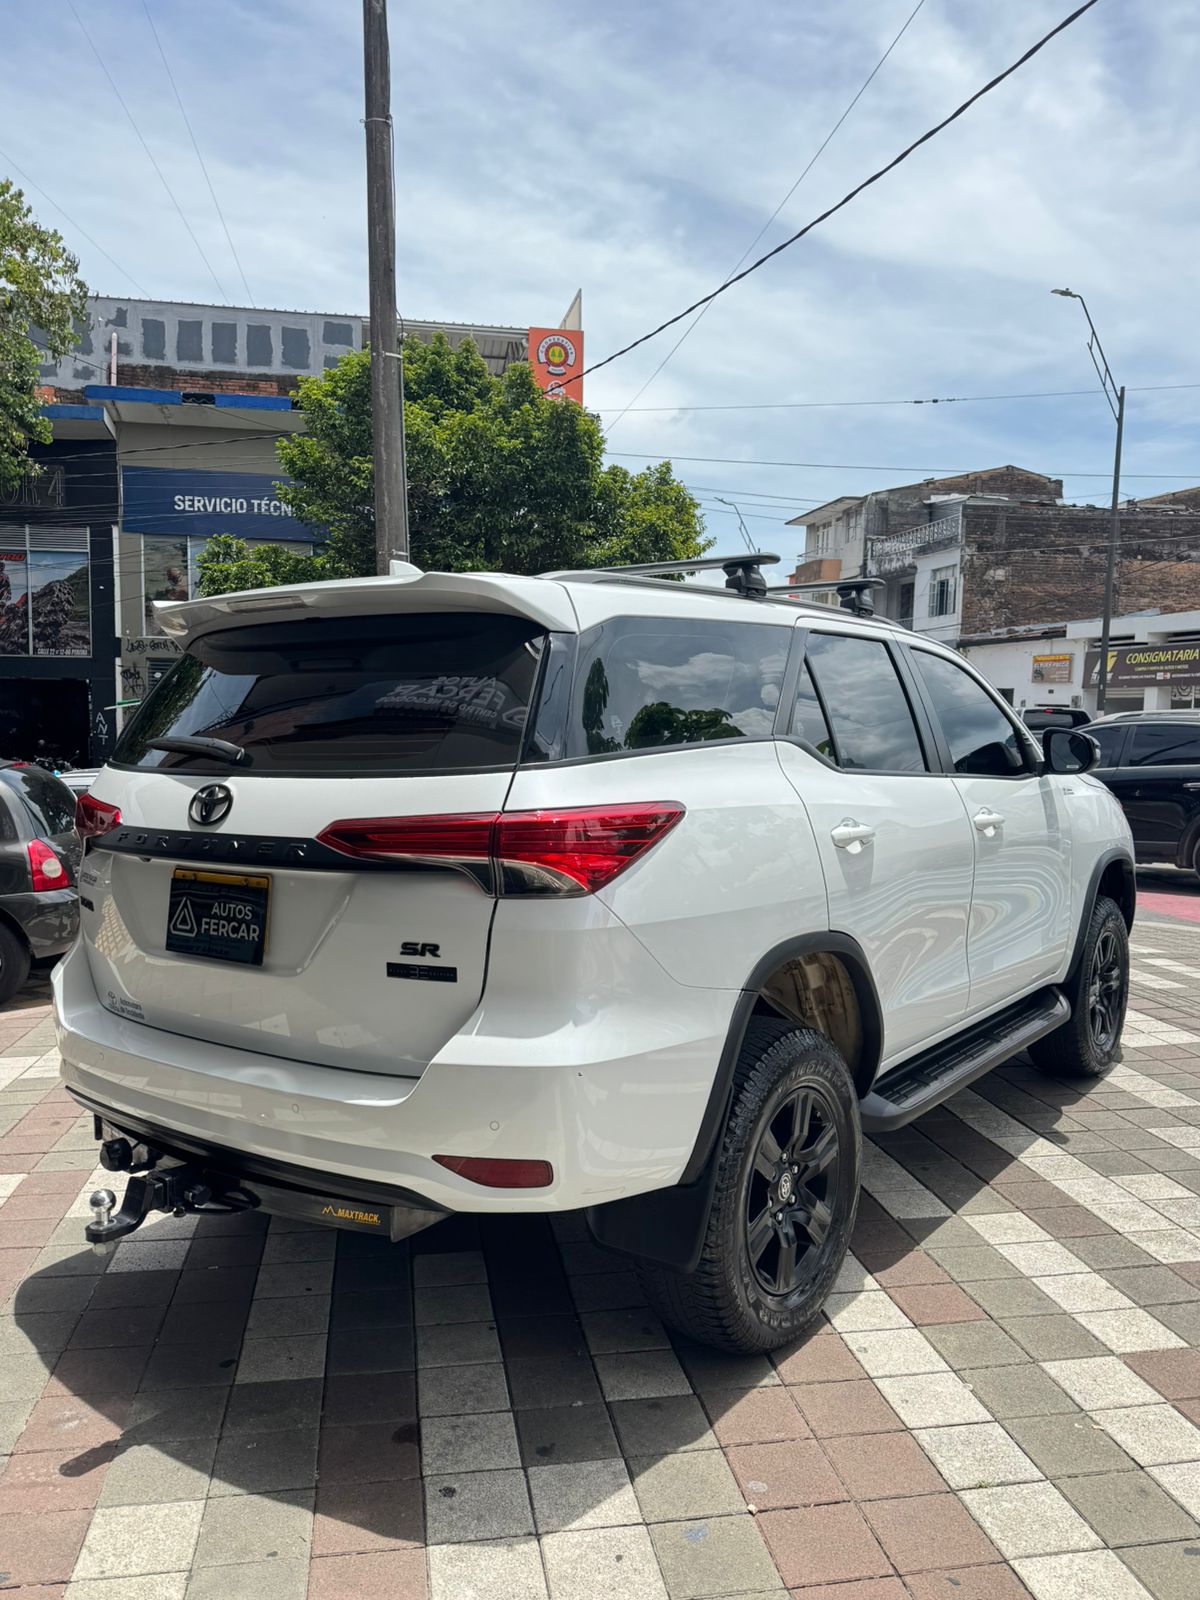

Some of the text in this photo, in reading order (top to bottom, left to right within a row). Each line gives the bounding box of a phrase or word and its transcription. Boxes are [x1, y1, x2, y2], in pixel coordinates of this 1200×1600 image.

[174, 495, 293, 517] SERVICIO TÉCN
[1126, 649, 1200, 664] CONSIGNATARIA
[116, 831, 308, 857] FORTUNER
[211, 901, 253, 920] AUTOS
[201, 918, 260, 942] FERCAR
[400, 942, 441, 958] SR
[336, 1208, 380, 1223] MAXTRACK
